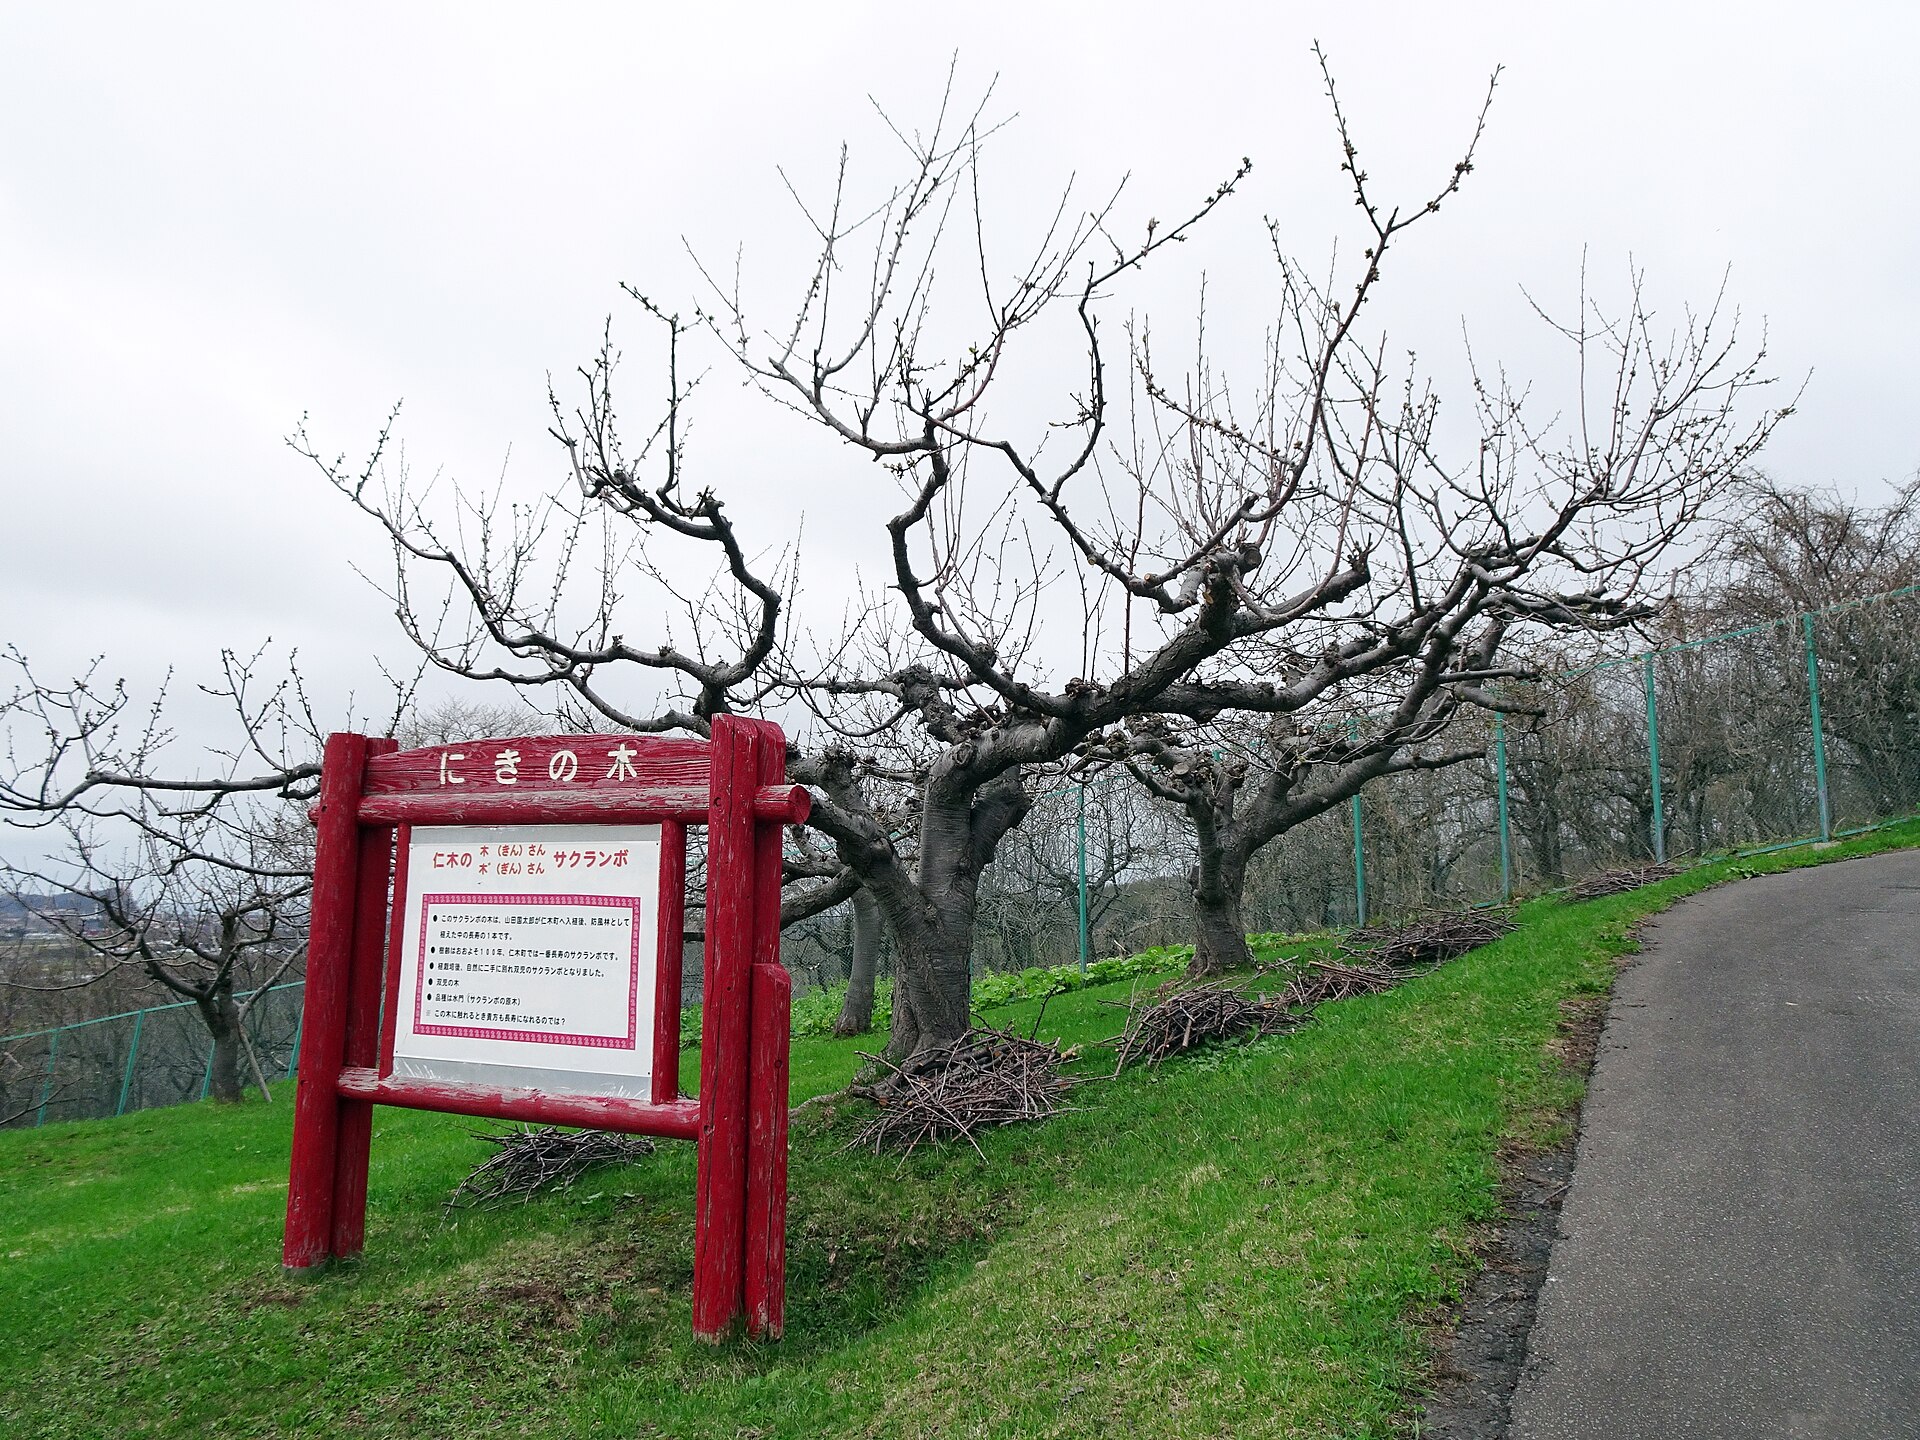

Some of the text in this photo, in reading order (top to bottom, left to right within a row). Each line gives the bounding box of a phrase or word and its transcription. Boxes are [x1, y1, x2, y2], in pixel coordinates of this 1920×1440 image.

[440, 744, 637, 784] にきの木
[433, 852, 472, 868] 仁木の
[553, 849, 629, 868] サクランボ
